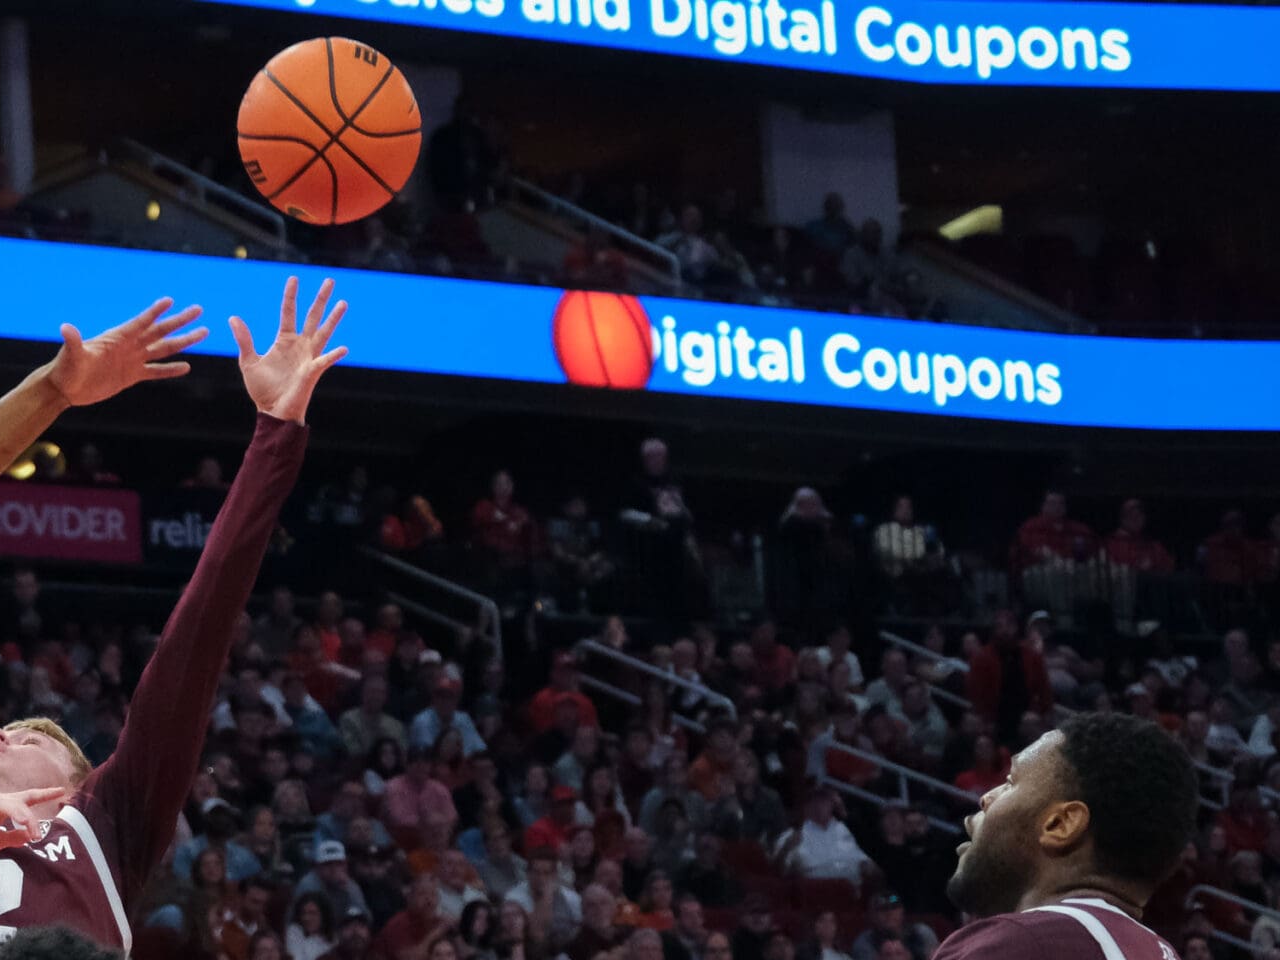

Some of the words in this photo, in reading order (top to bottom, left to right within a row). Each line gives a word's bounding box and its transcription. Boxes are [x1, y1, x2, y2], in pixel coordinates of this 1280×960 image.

[651, 0, 837, 55] Digital
[855, 6, 1132, 78] Coupons
[652, 315, 805, 387] igital
[822, 333, 1062, 406] Coupons
